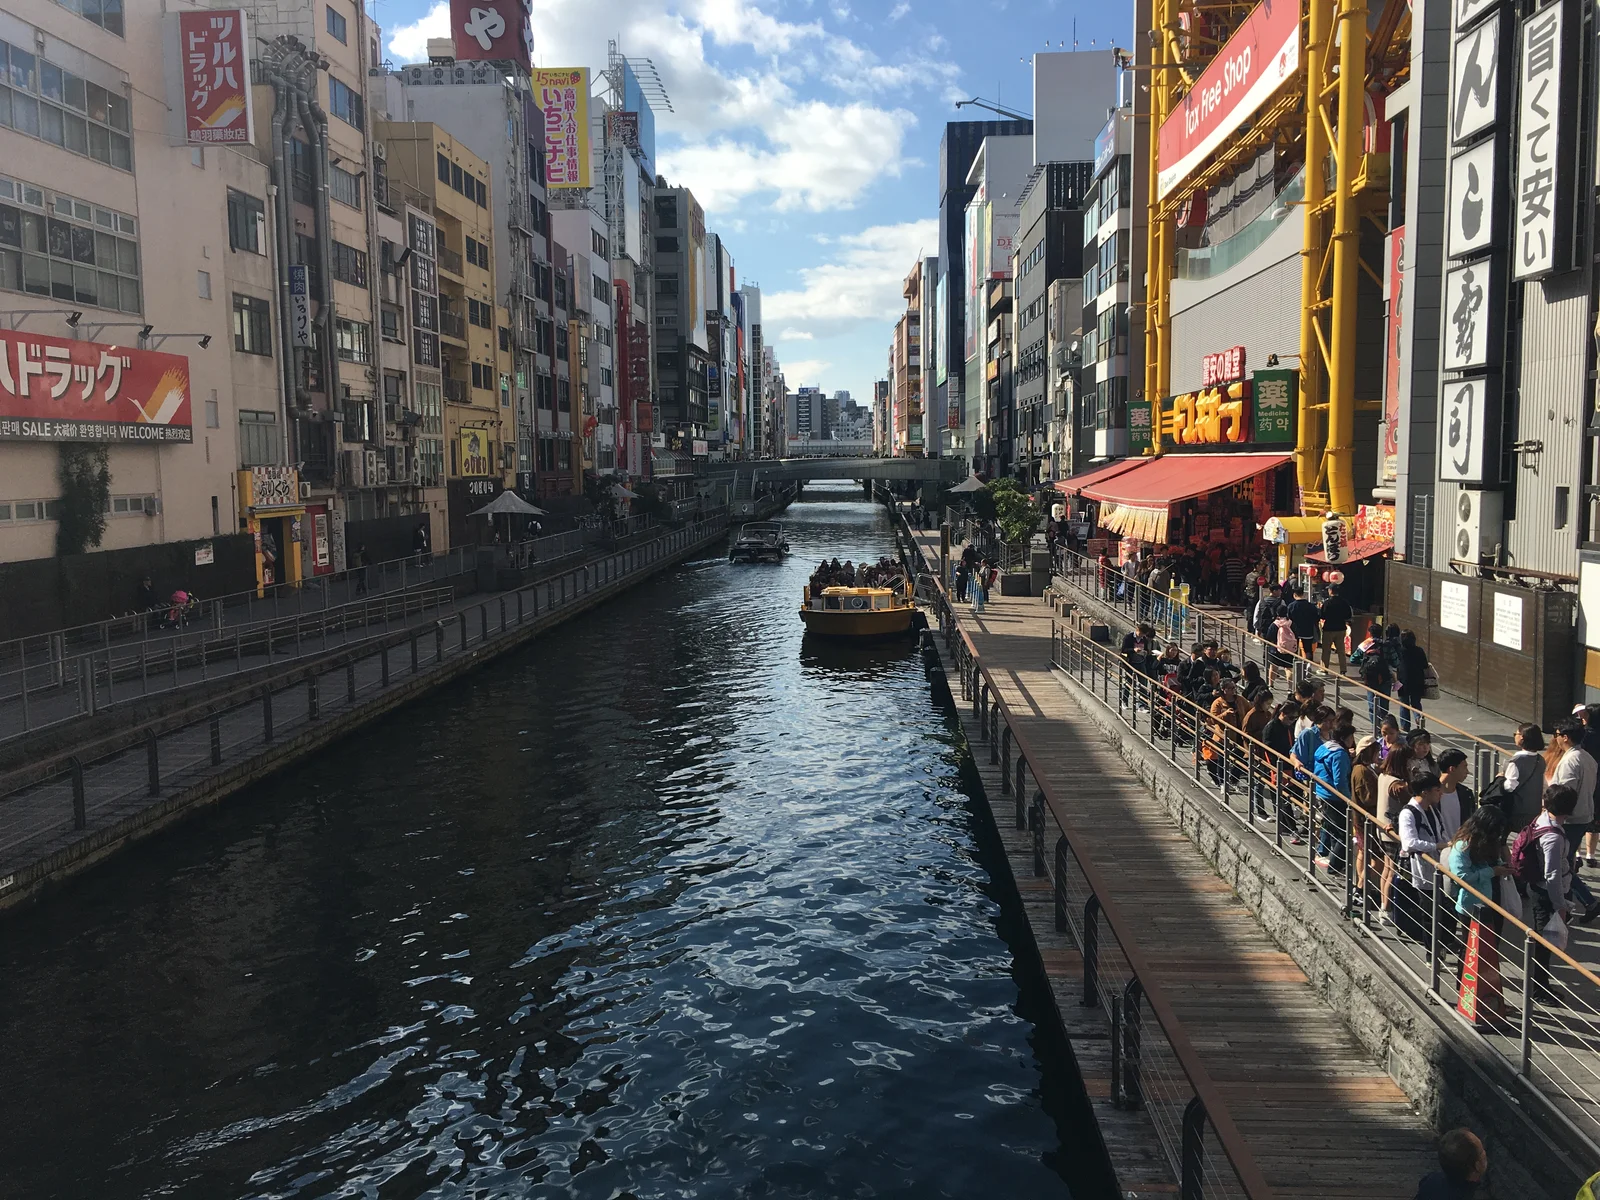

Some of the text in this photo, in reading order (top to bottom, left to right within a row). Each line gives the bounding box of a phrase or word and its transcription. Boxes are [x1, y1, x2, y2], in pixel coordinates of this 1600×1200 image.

[189, 31, 211, 110] ドラッグ
[210, 17, 238, 90] ツルハ
[1185, 45, 1251, 139] Tax Free Shop
[542, 88, 564, 183] いちごナビ
[564, 88, 578, 182] 高収入お仕事情報
[1522, 13, 1557, 268] 旨くて安い
[293, 269, 305, 293] 焼肉
[295, 295, 308, 345] いろりや
[1258, 379, 1289, 409] 薬
[0, 421, 20, 436] 판매
[22, 421, 51, 437] SALE
[79, 423, 117, 438] 환영합니다
[119, 425, 164, 440] WELCOME
[1130, 407, 1150, 427] 薬
[1259, 418, 1272, 431] 药
[1276, 418, 1289, 431] 약
[1367, 519, 1393, 538] たこ焼き
